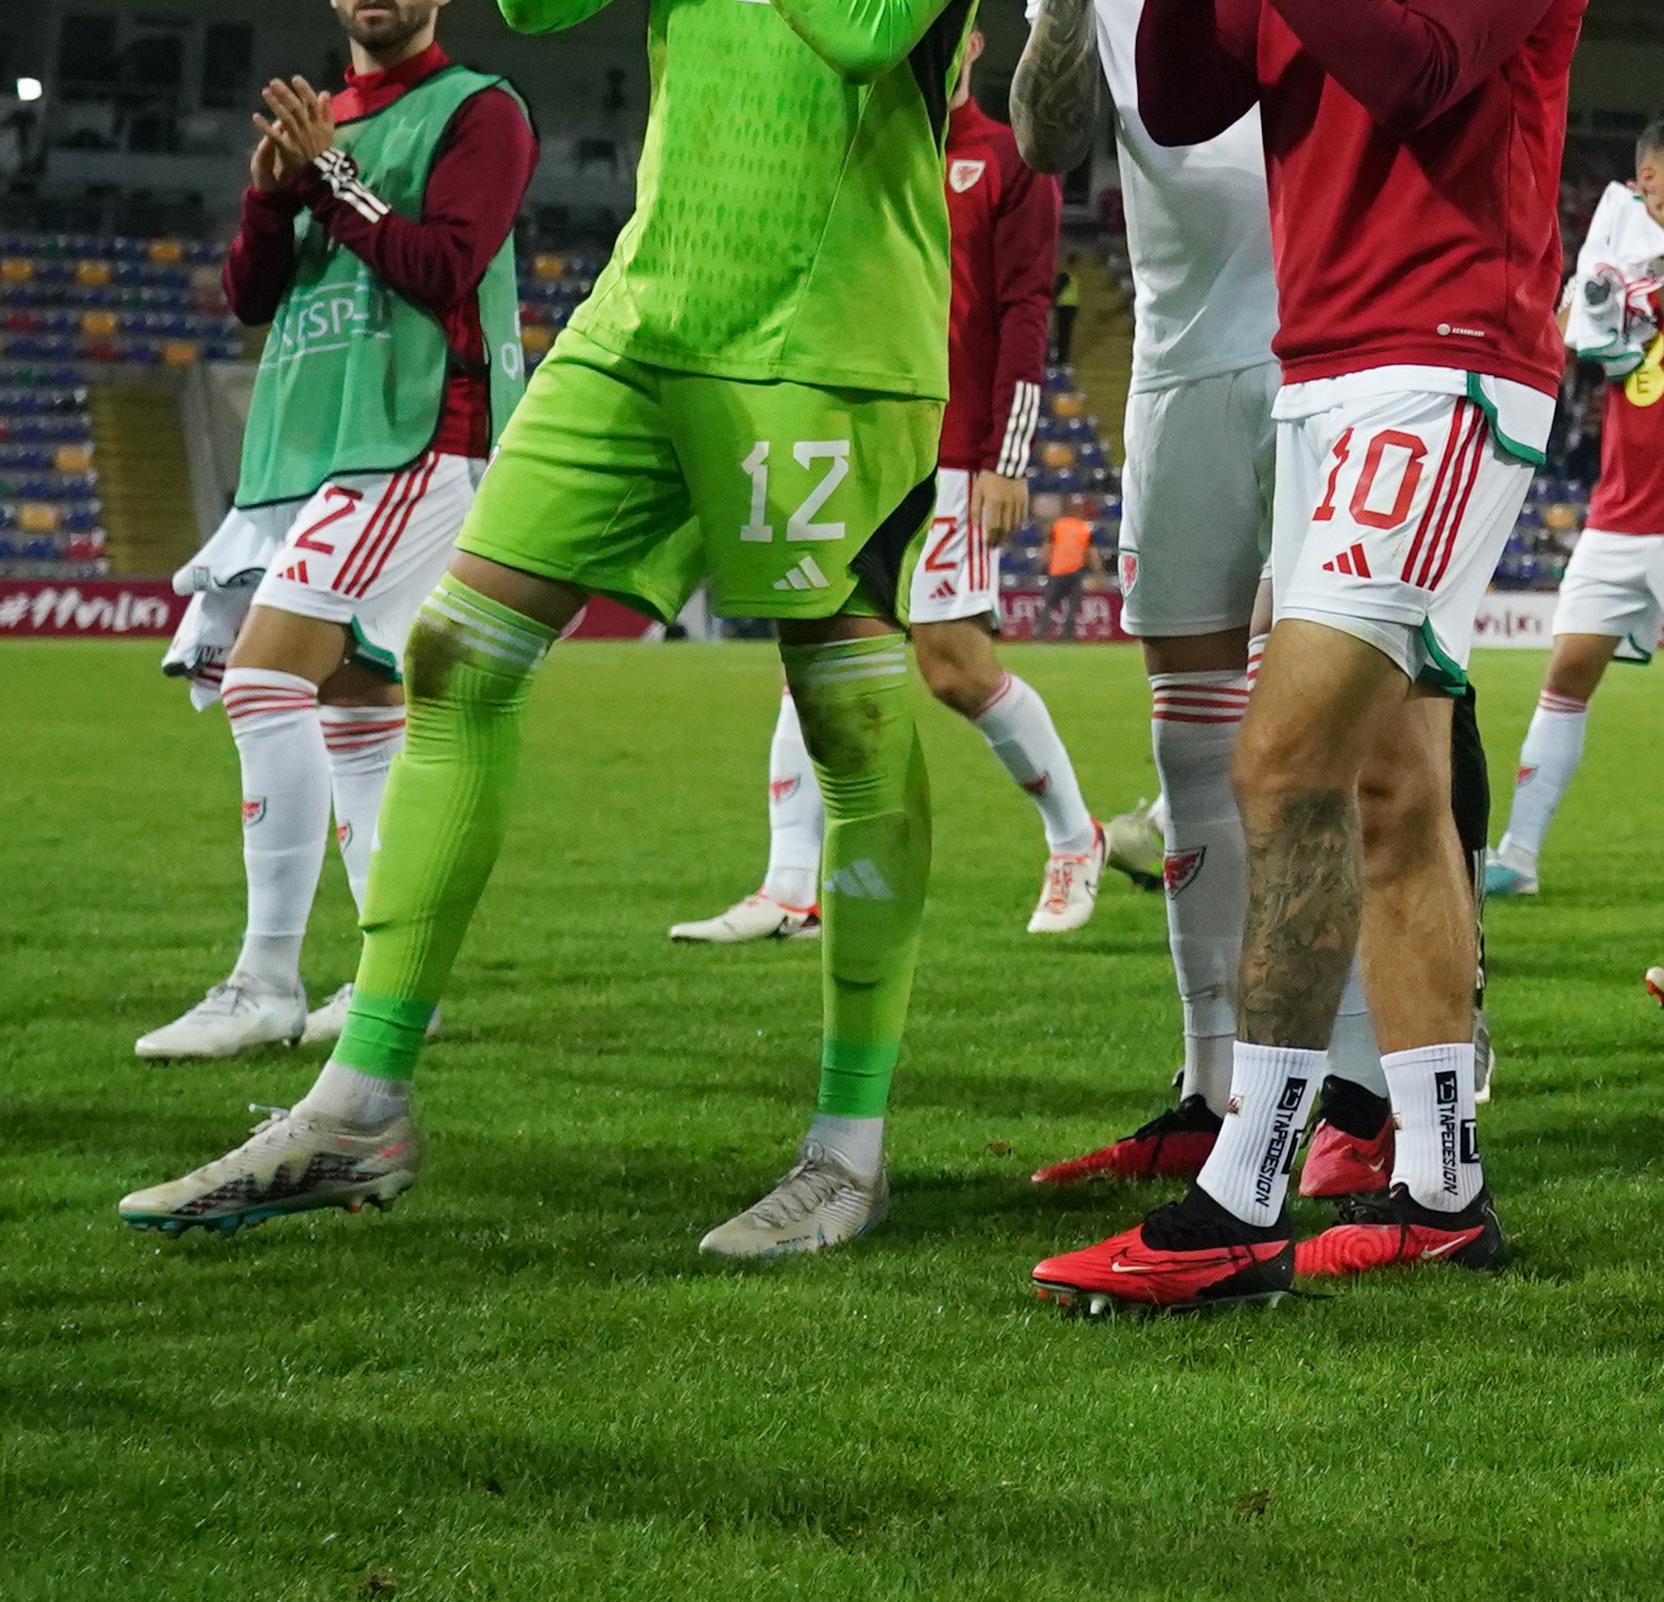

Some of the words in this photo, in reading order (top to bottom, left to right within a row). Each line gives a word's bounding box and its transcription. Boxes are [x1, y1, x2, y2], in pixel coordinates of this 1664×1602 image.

[740, 439, 850, 543] 12
[1311, 427, 1428, 530] 10
[1254, 1112, 1294, 1209] TAPEDESIGN
[1439, 1103, 1459, 1196] TAPEDESIGN
